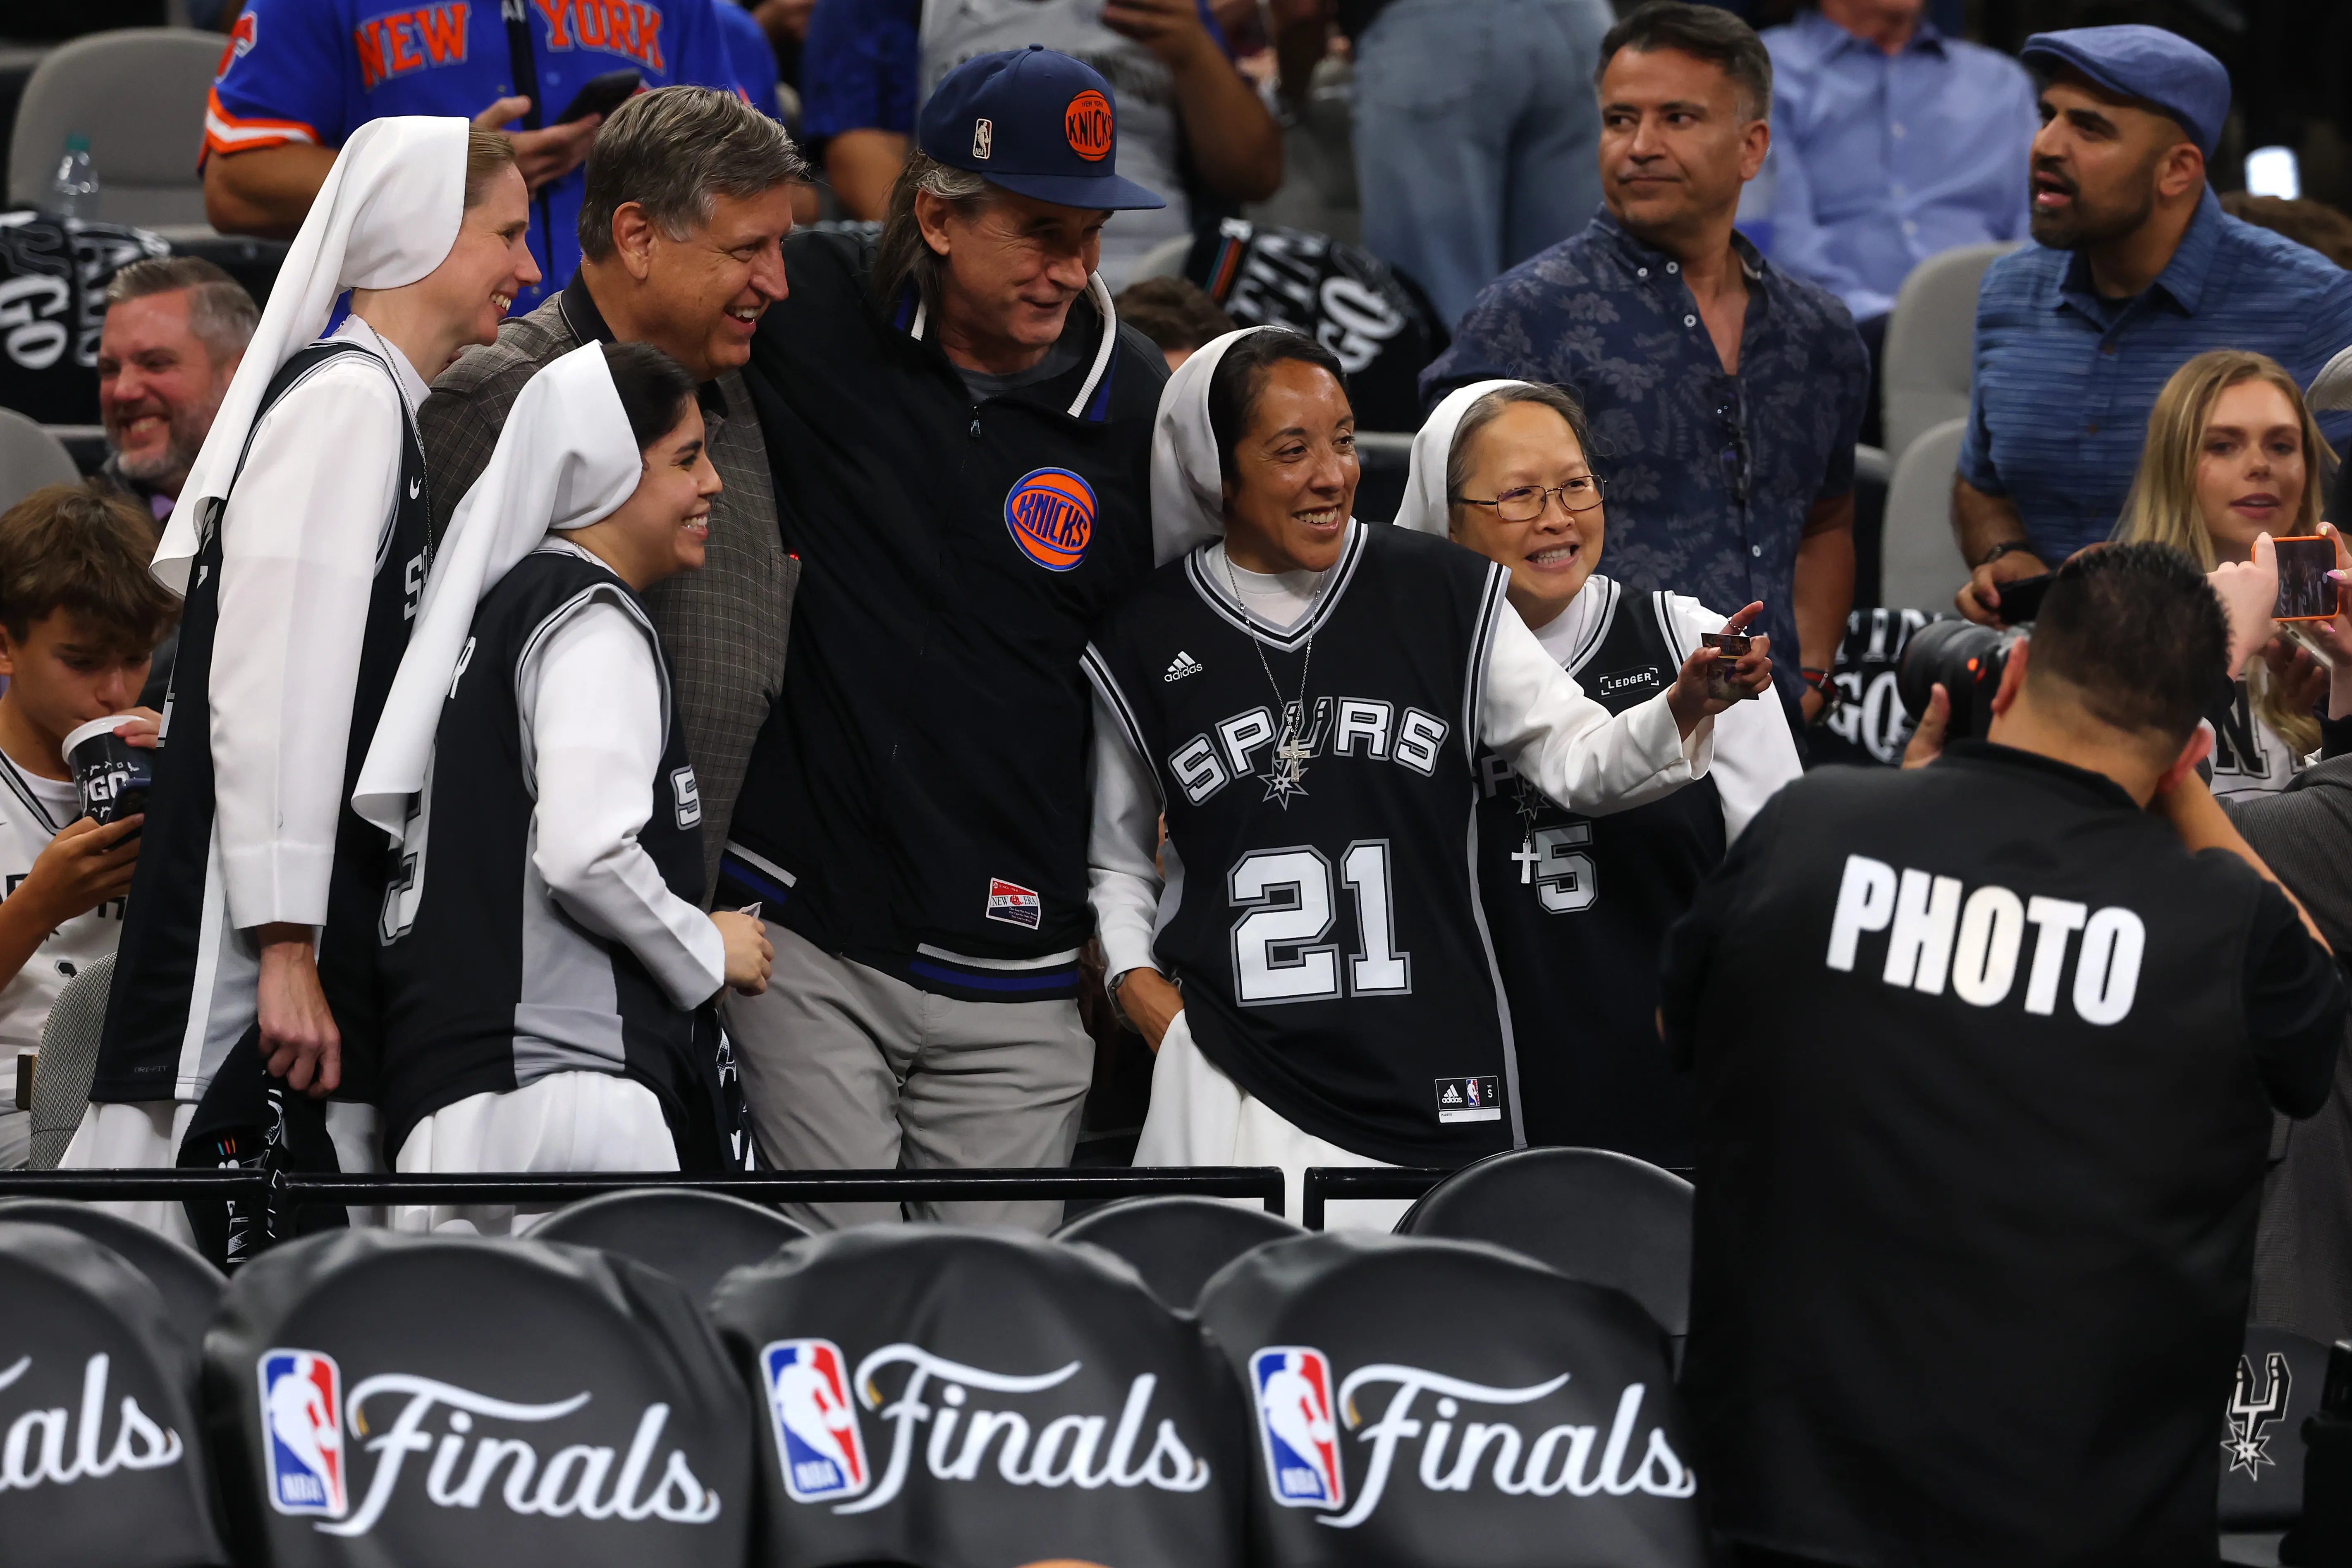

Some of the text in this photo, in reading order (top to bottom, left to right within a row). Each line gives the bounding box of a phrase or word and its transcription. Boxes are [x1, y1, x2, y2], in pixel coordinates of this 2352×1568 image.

[354, 0, 665, 93] NEW YORK
[1068, 109, 1113, 148] KNICKS
[1016, 493, 1088, 548] KNICKS
[1164, 663, 1203, 682] adidas
[1607, 671, 1652, 690] LEDGER
[1168, 696, 1450, 807] SPURS
[992, 896, 1037, 906] NEW ERA
[1531, 820, 1599, 915] 5
[1227, 838, 1412, 1007] 21
[1826, 854, 2146, 1026] PHOTO
[1487, 1089, 1493, 1098] S
[0, 1352, 184, 1489] als
[313, 1374, 720, 1536] Finals
[830, 1343, 1210, 1514] Finals
[1315, 1364, 1696, 1528] Finals
